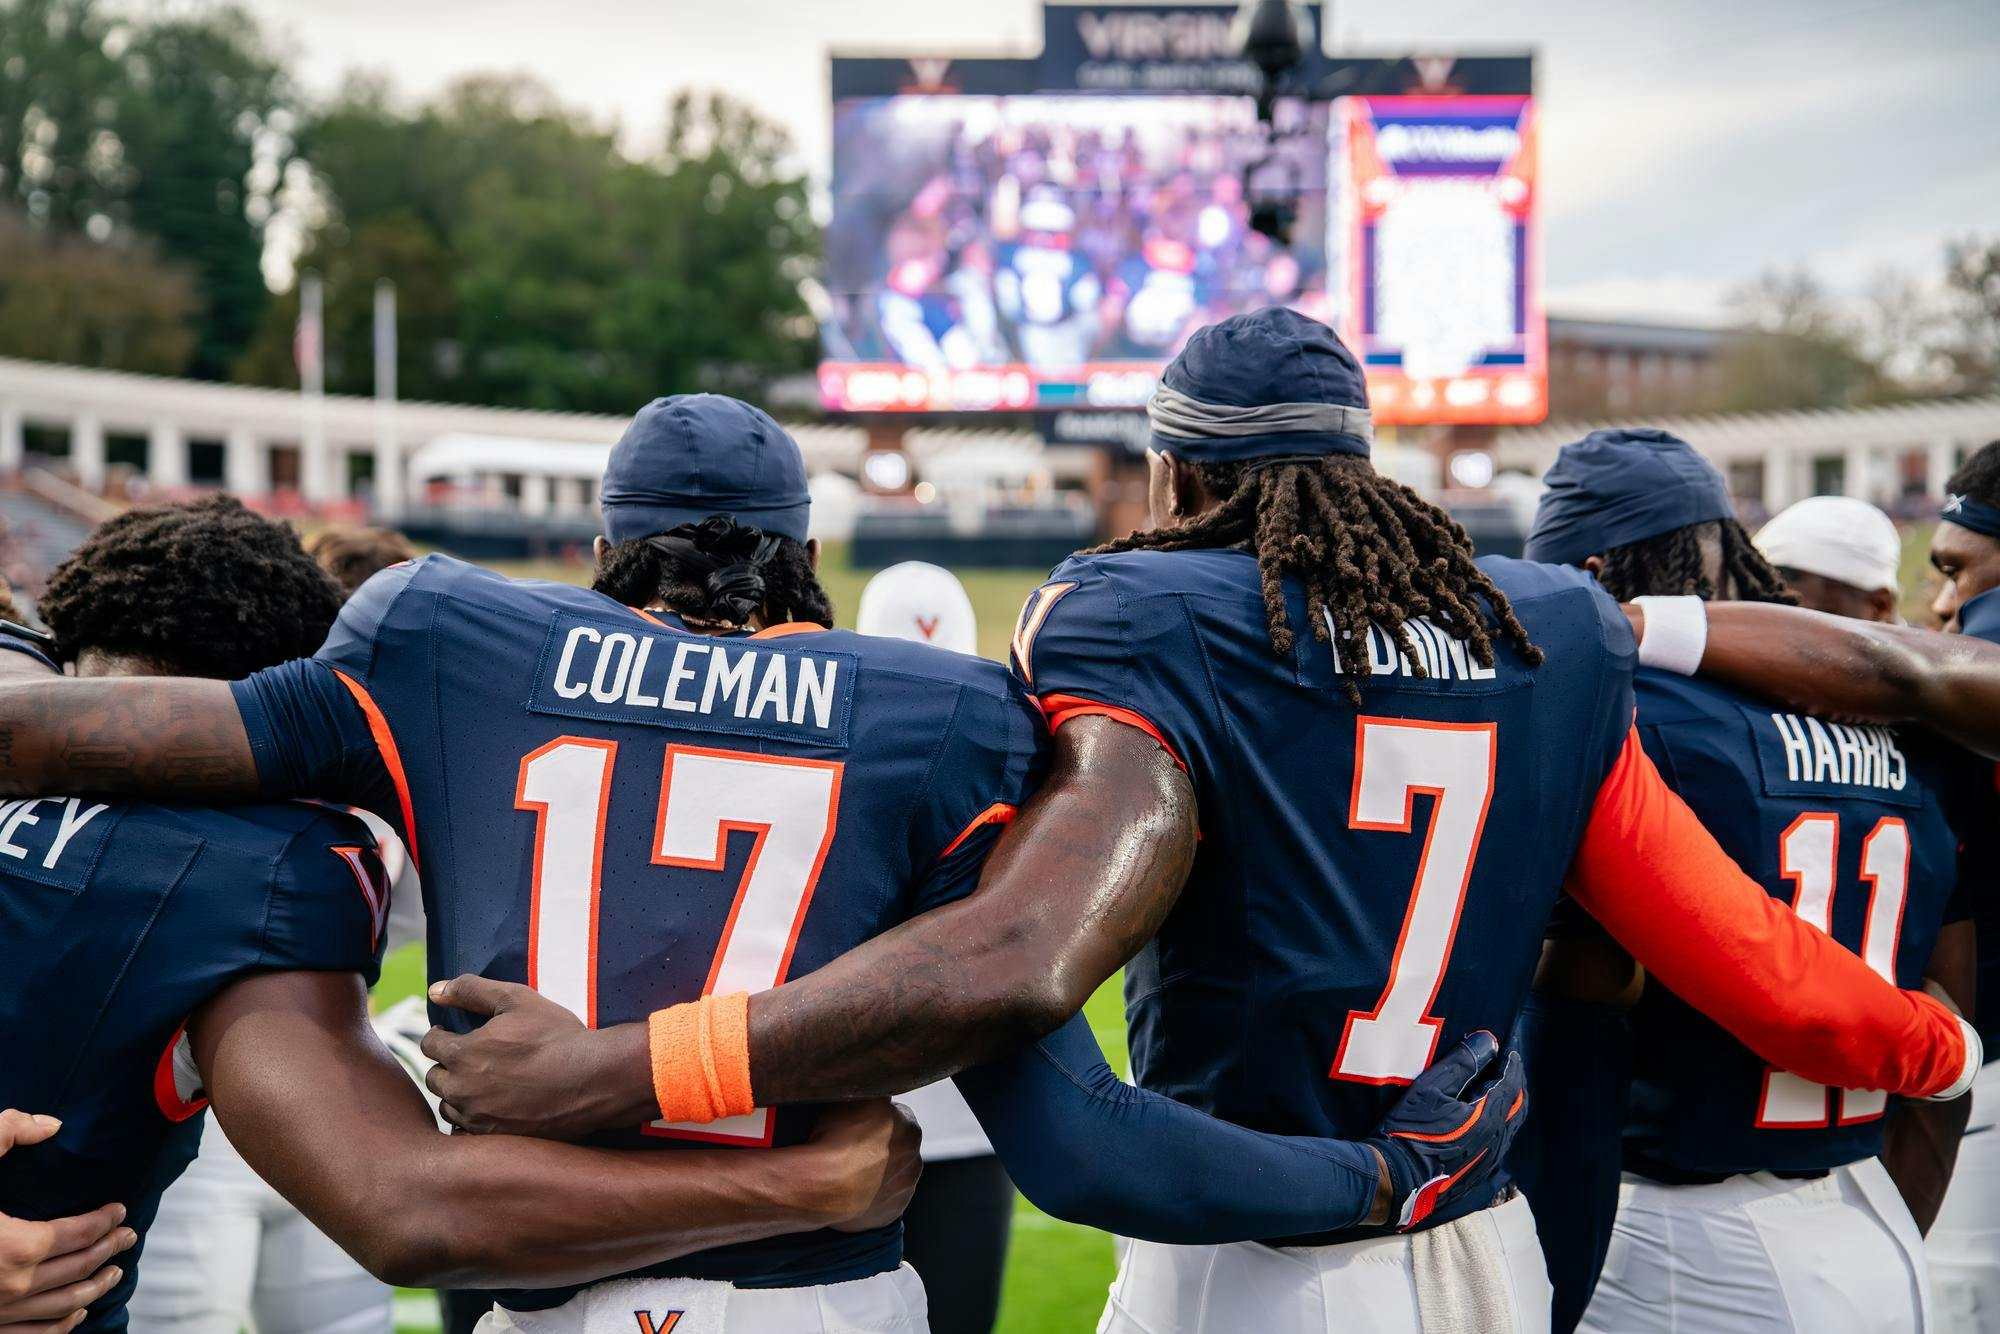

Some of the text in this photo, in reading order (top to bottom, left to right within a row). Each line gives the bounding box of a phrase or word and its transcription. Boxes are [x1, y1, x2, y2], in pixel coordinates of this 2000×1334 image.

[554, 626, 838, 729] COLEMAN
[916, 614, 939, 641] V
[1771, 713, 1906, 791] HARRIS
[514, 735, 846, 1148] 17
[1329, 714, 1498, 1087] 7
[1754, 811, 1911, 1128] 11
